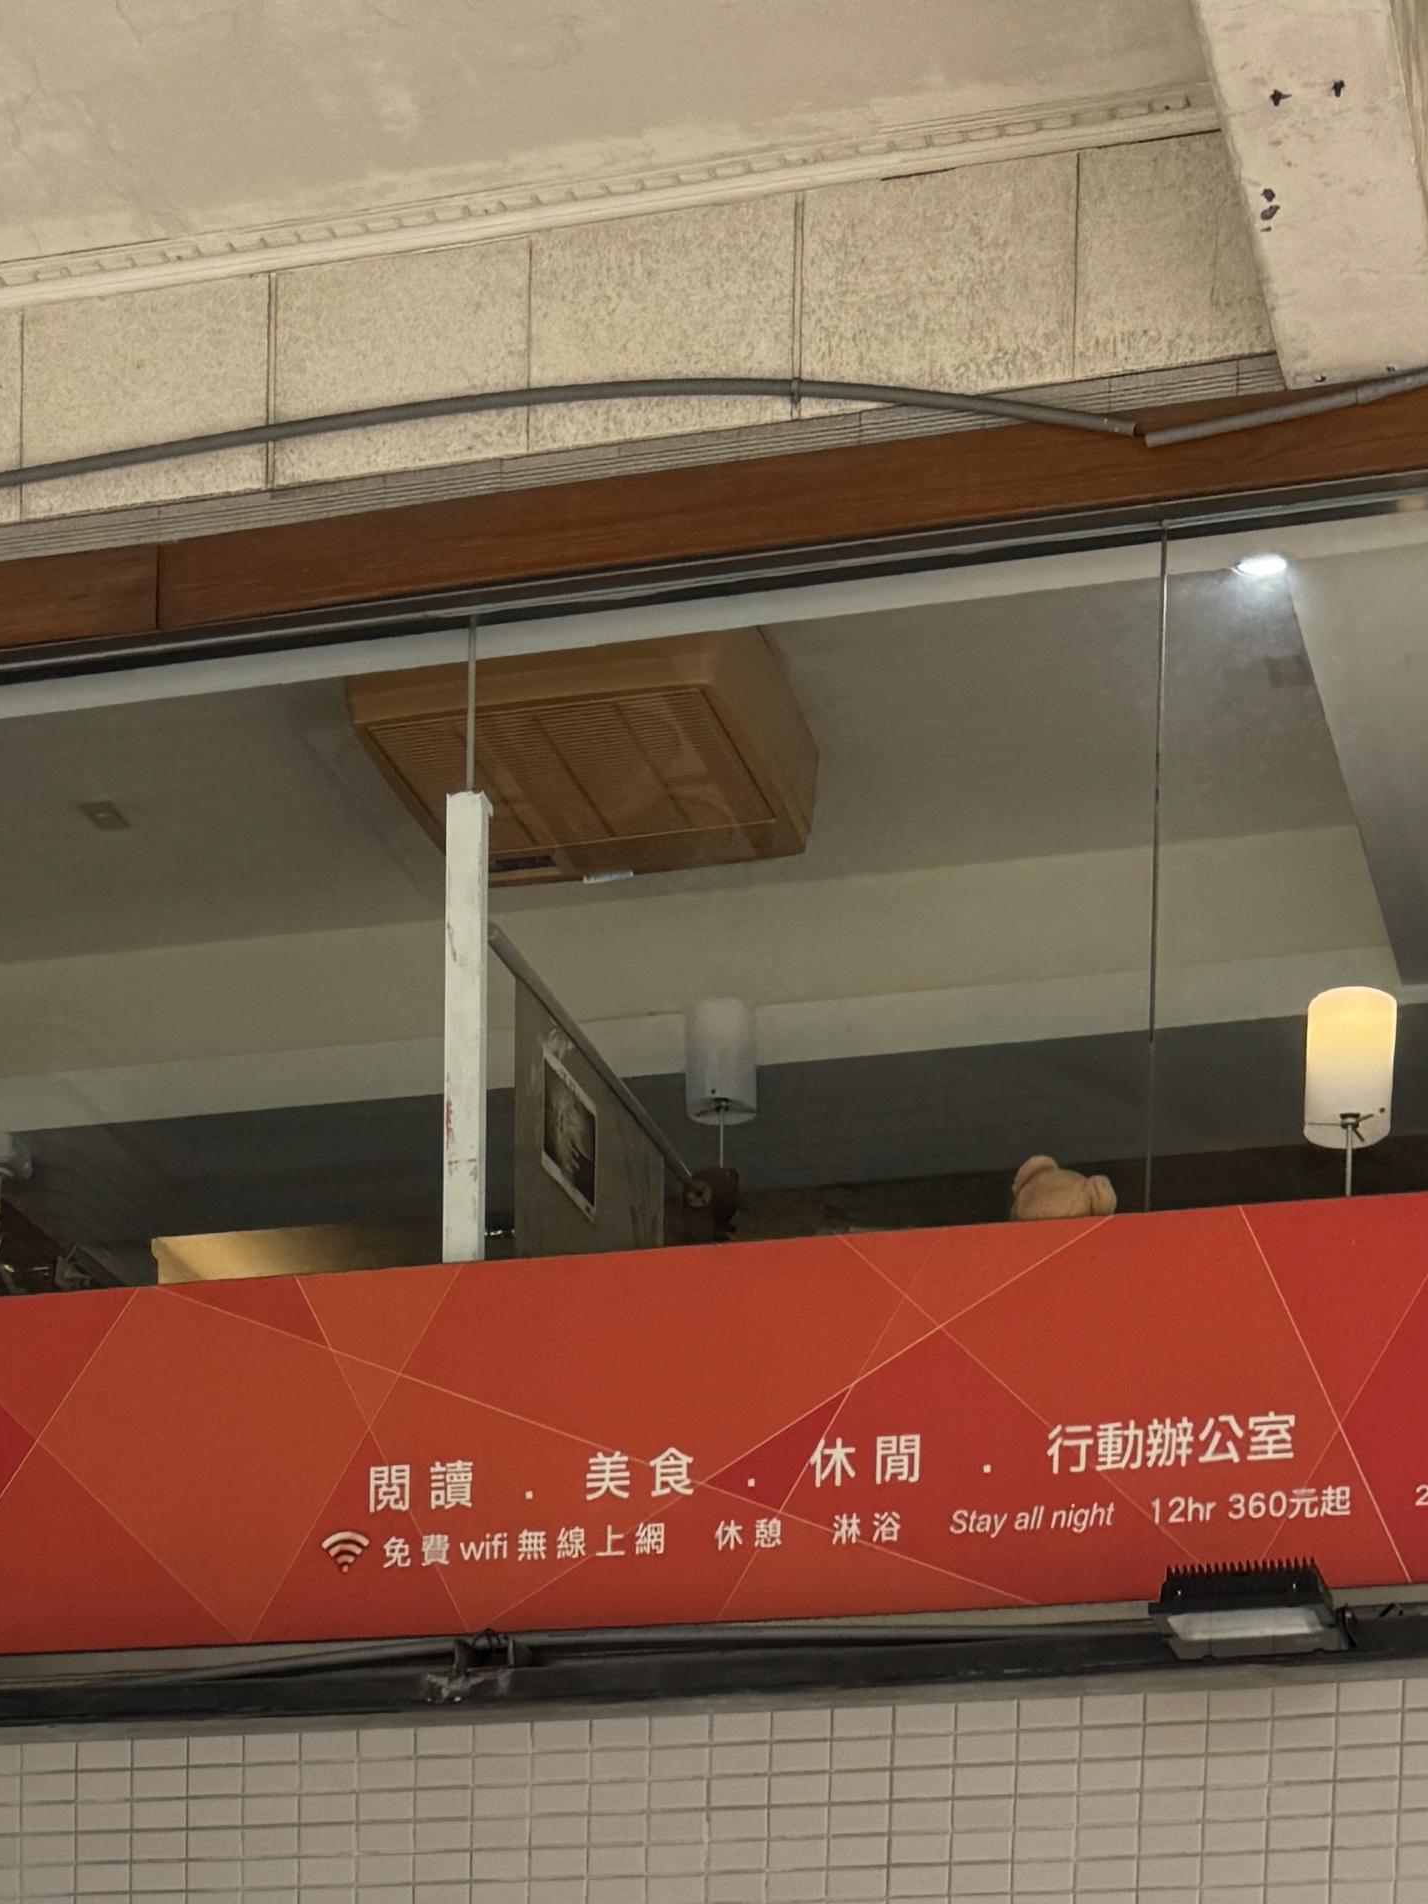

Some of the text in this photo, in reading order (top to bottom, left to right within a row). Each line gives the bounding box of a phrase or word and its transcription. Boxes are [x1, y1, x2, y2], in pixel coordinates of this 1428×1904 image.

[368, 1411, 1297, 1513] 閱讀 美食 休閒 行動辦公室
[713, 1516, 783, 1551] 休憩
[831, 1511, 902, 1546] 淋浴
[948, 1509, 1009, 1538] Stay
[1013, 1508, 1045, 1532] all
[1050, 1503, 1116, 1534] night
[1150, 1496, 1216, 1526] 12hr
[1227, 1485, 1351, 1520] 360元起
